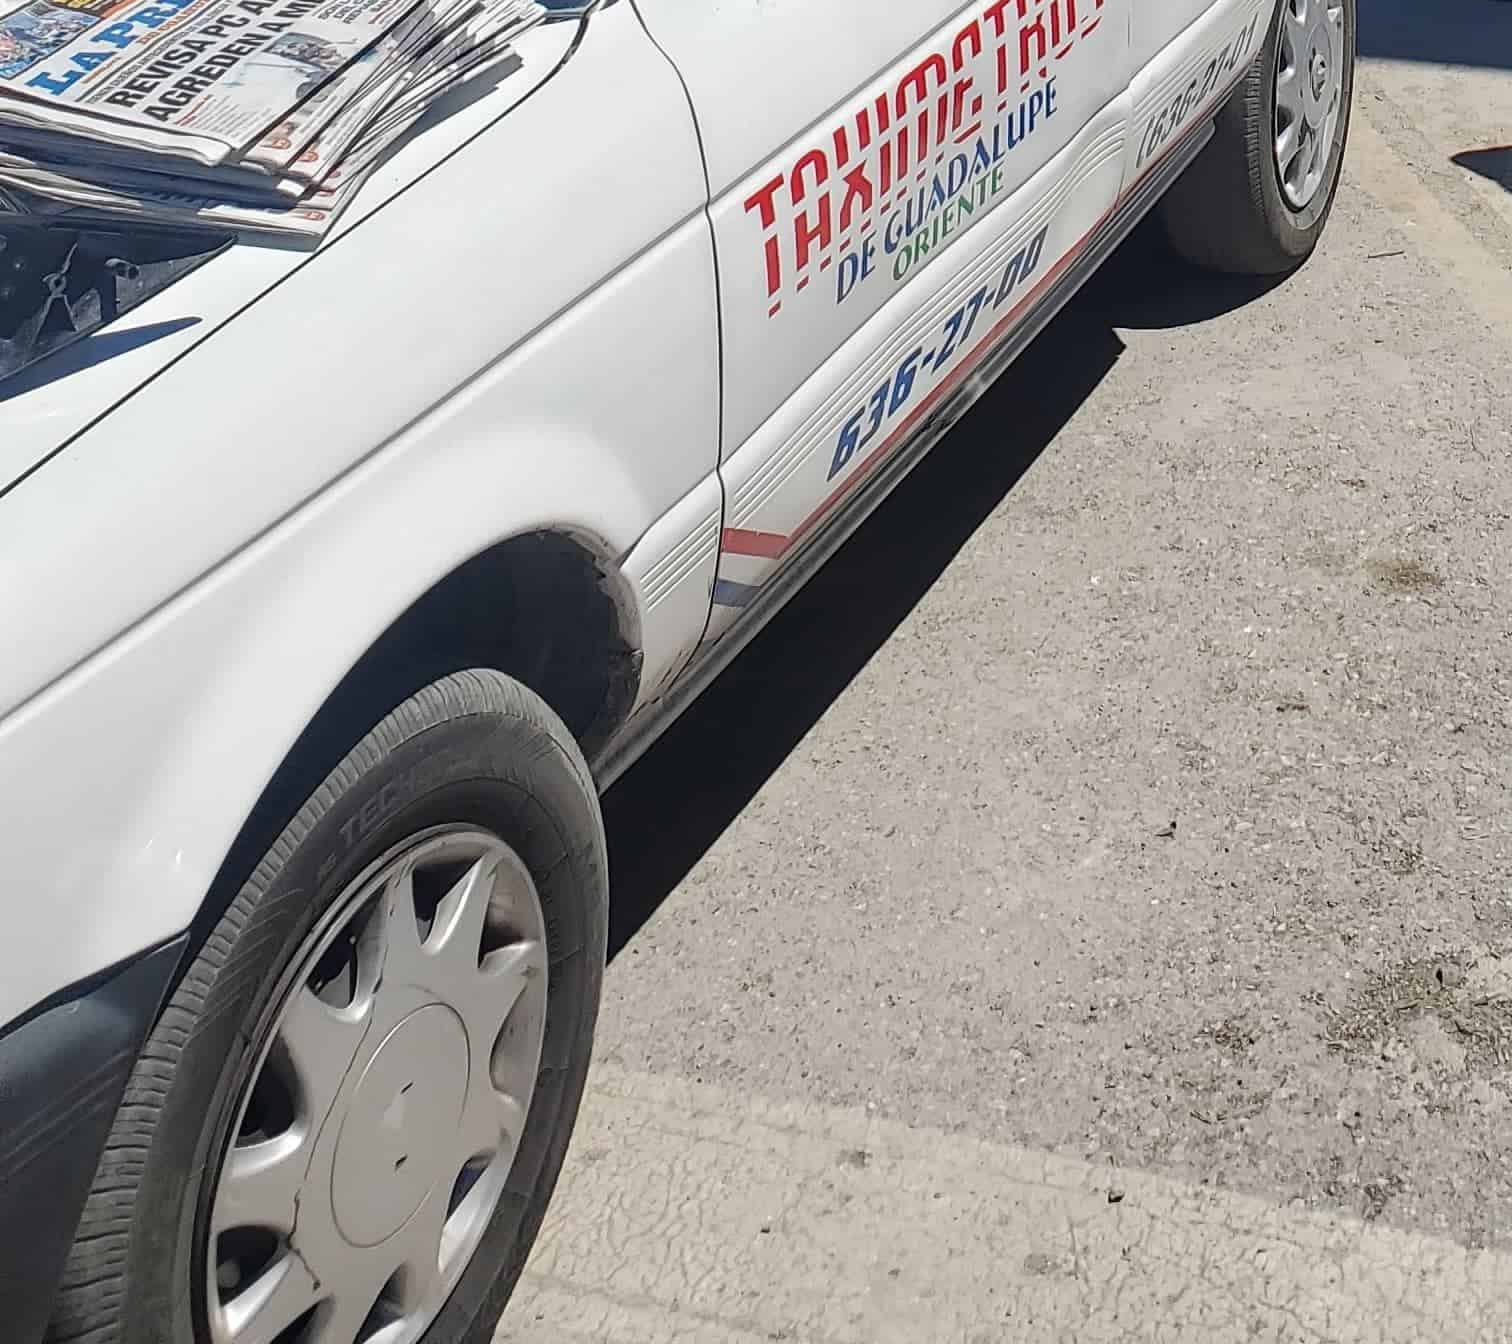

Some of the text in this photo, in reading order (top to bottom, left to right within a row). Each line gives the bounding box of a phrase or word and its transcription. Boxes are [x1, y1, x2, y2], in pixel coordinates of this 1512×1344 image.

[25, 51, 119, 97] LA
[104, 35, 217, 109] REVISA
[198, 13, 251, 39] PC
[142, 30, 274, 123] AGREDEN
[263, 21, 295, 34] A
[836, 74, 1057, 305] DE GUADALUPE
[893, 160, 1005, 281] ORIENTE
[826, 222, 1050, 483] 636-27-00
